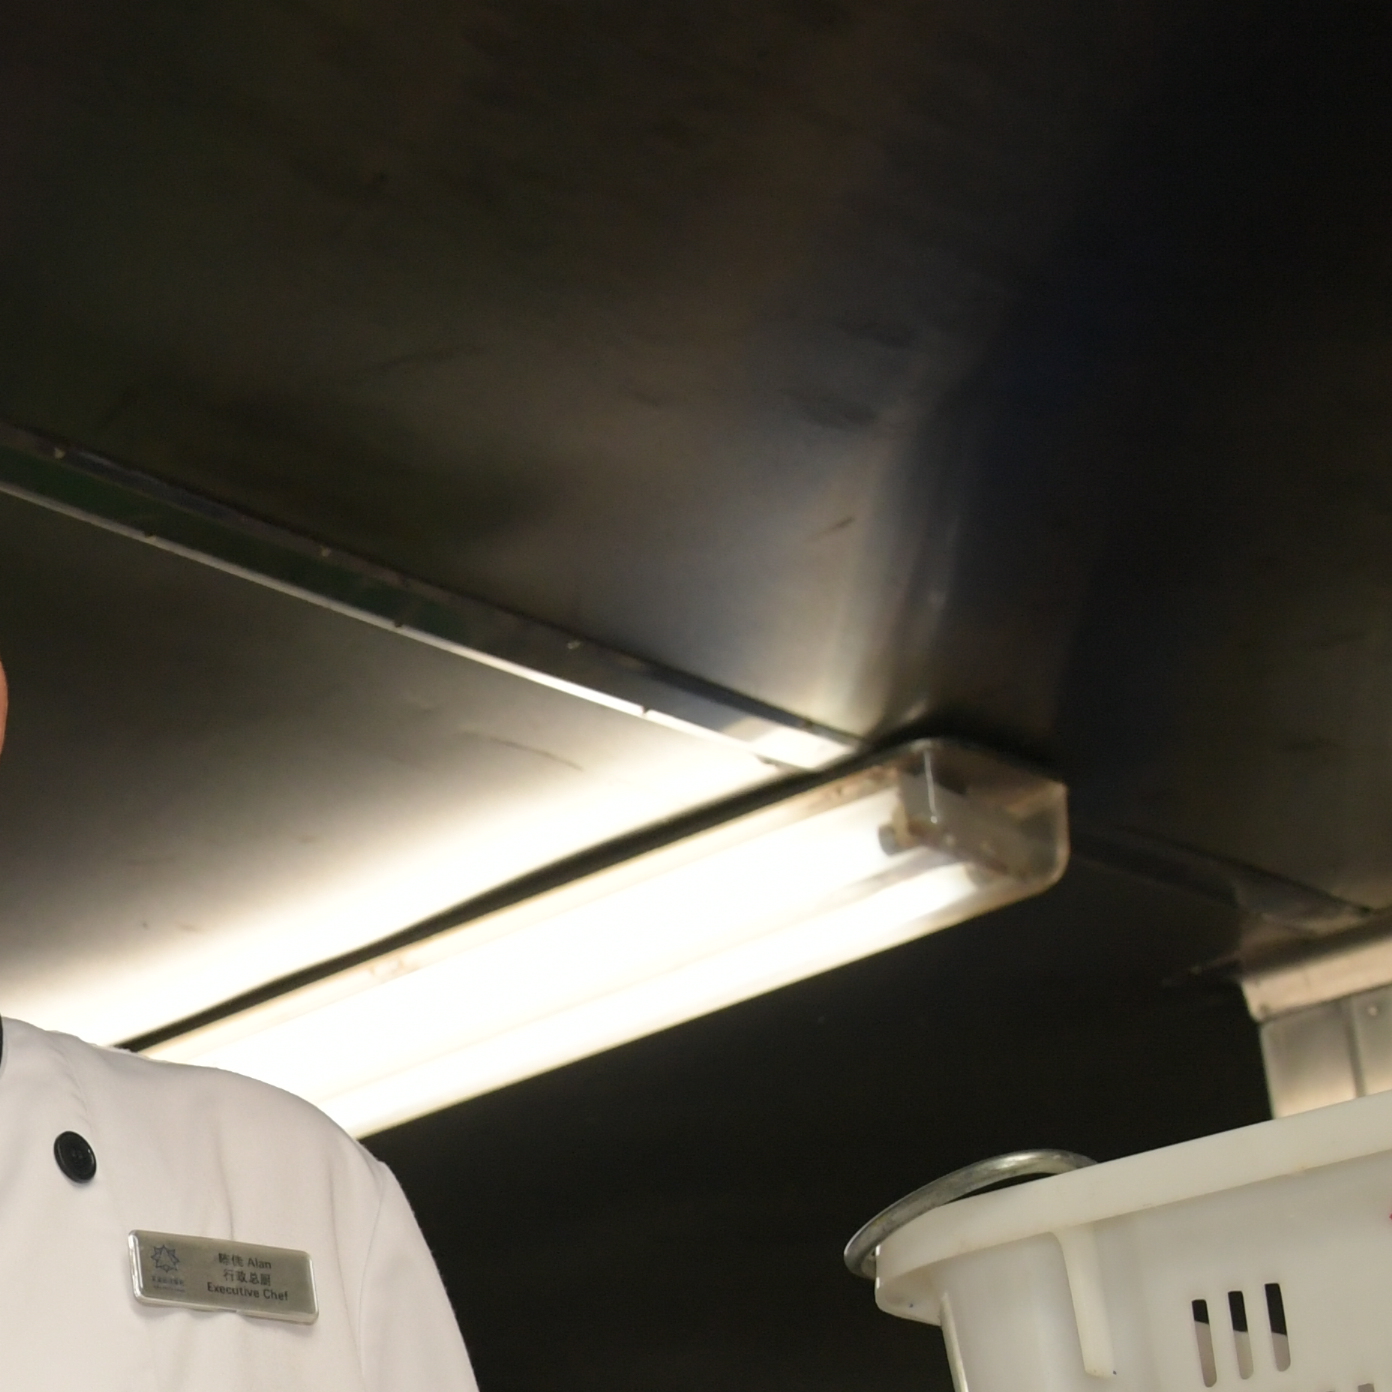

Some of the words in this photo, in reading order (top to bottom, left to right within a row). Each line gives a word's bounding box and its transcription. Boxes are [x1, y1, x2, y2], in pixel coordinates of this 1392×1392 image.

[247, 1257, 272, 1270] Alan
[223, 1268, 272, 1286] 行政总厨
[207, 1282, 259, 1298] Executive
[263, 1289, 288, 1301] Chef
